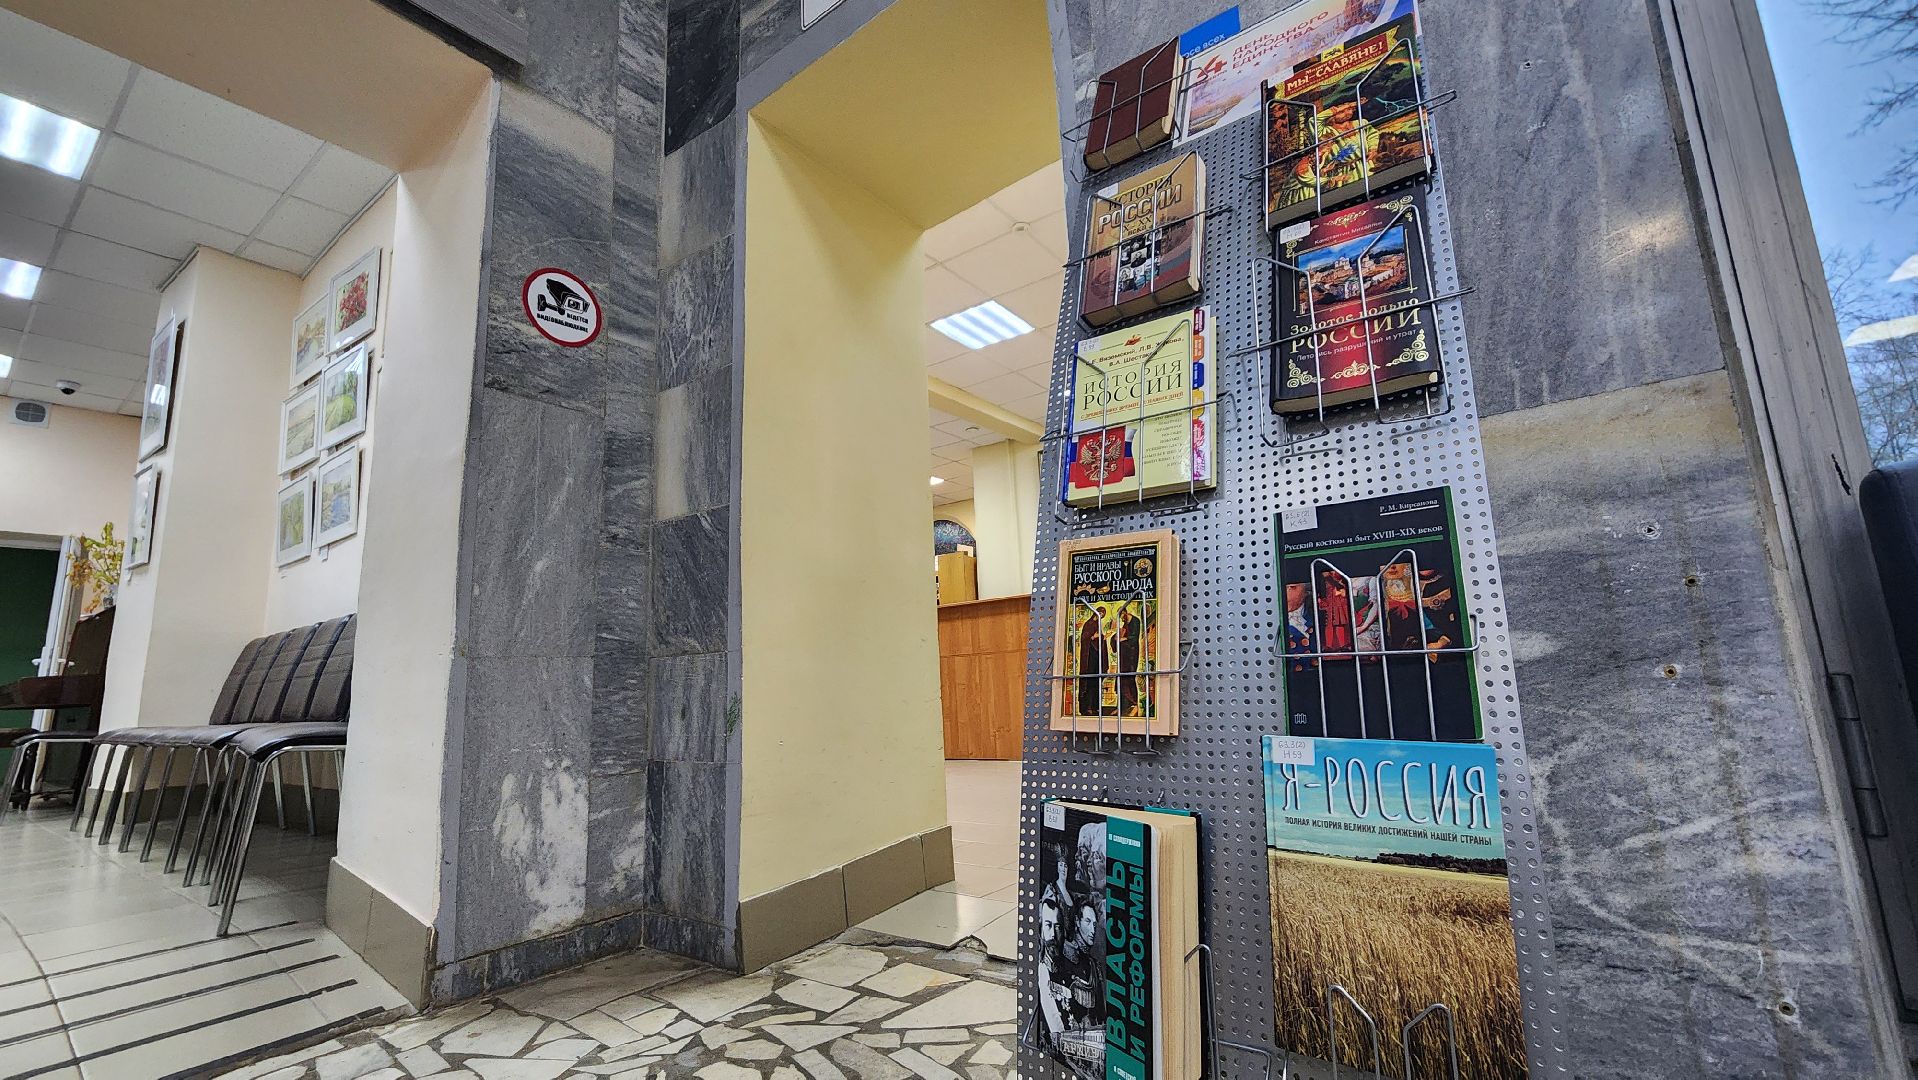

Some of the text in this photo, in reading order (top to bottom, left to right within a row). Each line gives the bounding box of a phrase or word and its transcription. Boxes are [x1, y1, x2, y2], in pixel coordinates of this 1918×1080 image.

[1232, 27, 1314, 69] ЕДИНСТВА
[1233, 12, 1328, 61] НАРОДНОГО
[1233, 34, 1272, 56] ДЕНЬ
[1098, 184, 1181, 234] РОССИИ
[1290, 308, 1422, 353] РОССИИ
[1296, 350, 1332, 361] Летоись
[1393, 328, 1417, 339] утрат
[1083, 373, 1182, 410] РОССИИ
[1084, 360, 1182, 394] ИСТОРИЯ
[1399, 499, 1438, 511] Кирсанова
[1284, 541, 1314, 552] Русский
[1315, 538, 1345, 548] костюм
[1417, 524, 1443, 534] веков
[1074, 563, 1089, 573] БЫТ
[1096, 560, 1121, 571] НРАВЫ
[1074, 569, 1122, 584] РУССКОГО
[1112, 577, 1153, 592] НАРОДА
[1285, 816, 1492, 846] ПОЛНАЯ ИСТОРИЯ ВЕЛИКИХ ДОСТИЖЕНИЙ НАШЕЙ СТРАНЫ
[1106, 861, 1127, 1049] ВЛАСТЬ
[1130, 867, 1145, 1027] РЕФОРМЫ
